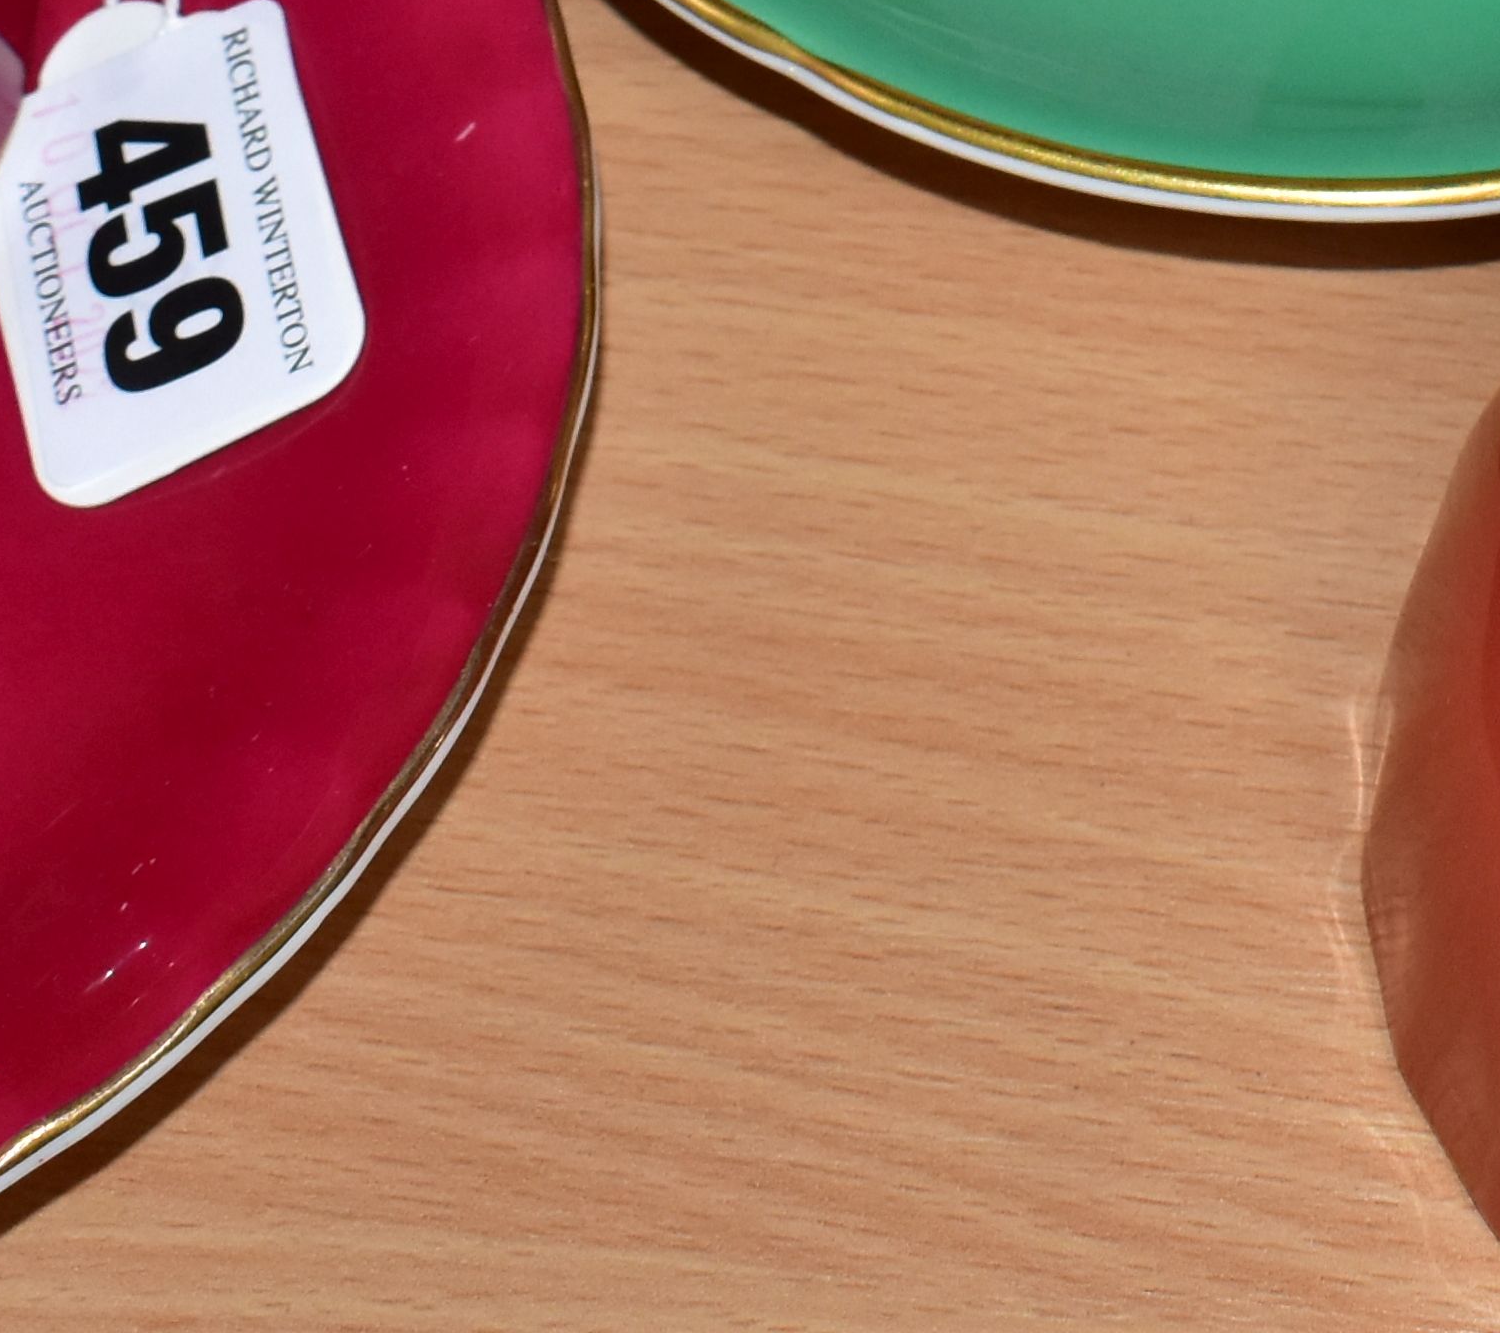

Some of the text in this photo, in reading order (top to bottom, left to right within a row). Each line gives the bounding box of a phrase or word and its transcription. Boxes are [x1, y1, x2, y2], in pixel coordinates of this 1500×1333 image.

[20, 179, 83, 406] AUCTIONEERS
[76, 119, 246, 393] 459
[222, 26, 314, 375] RICHARD WINTERTON
